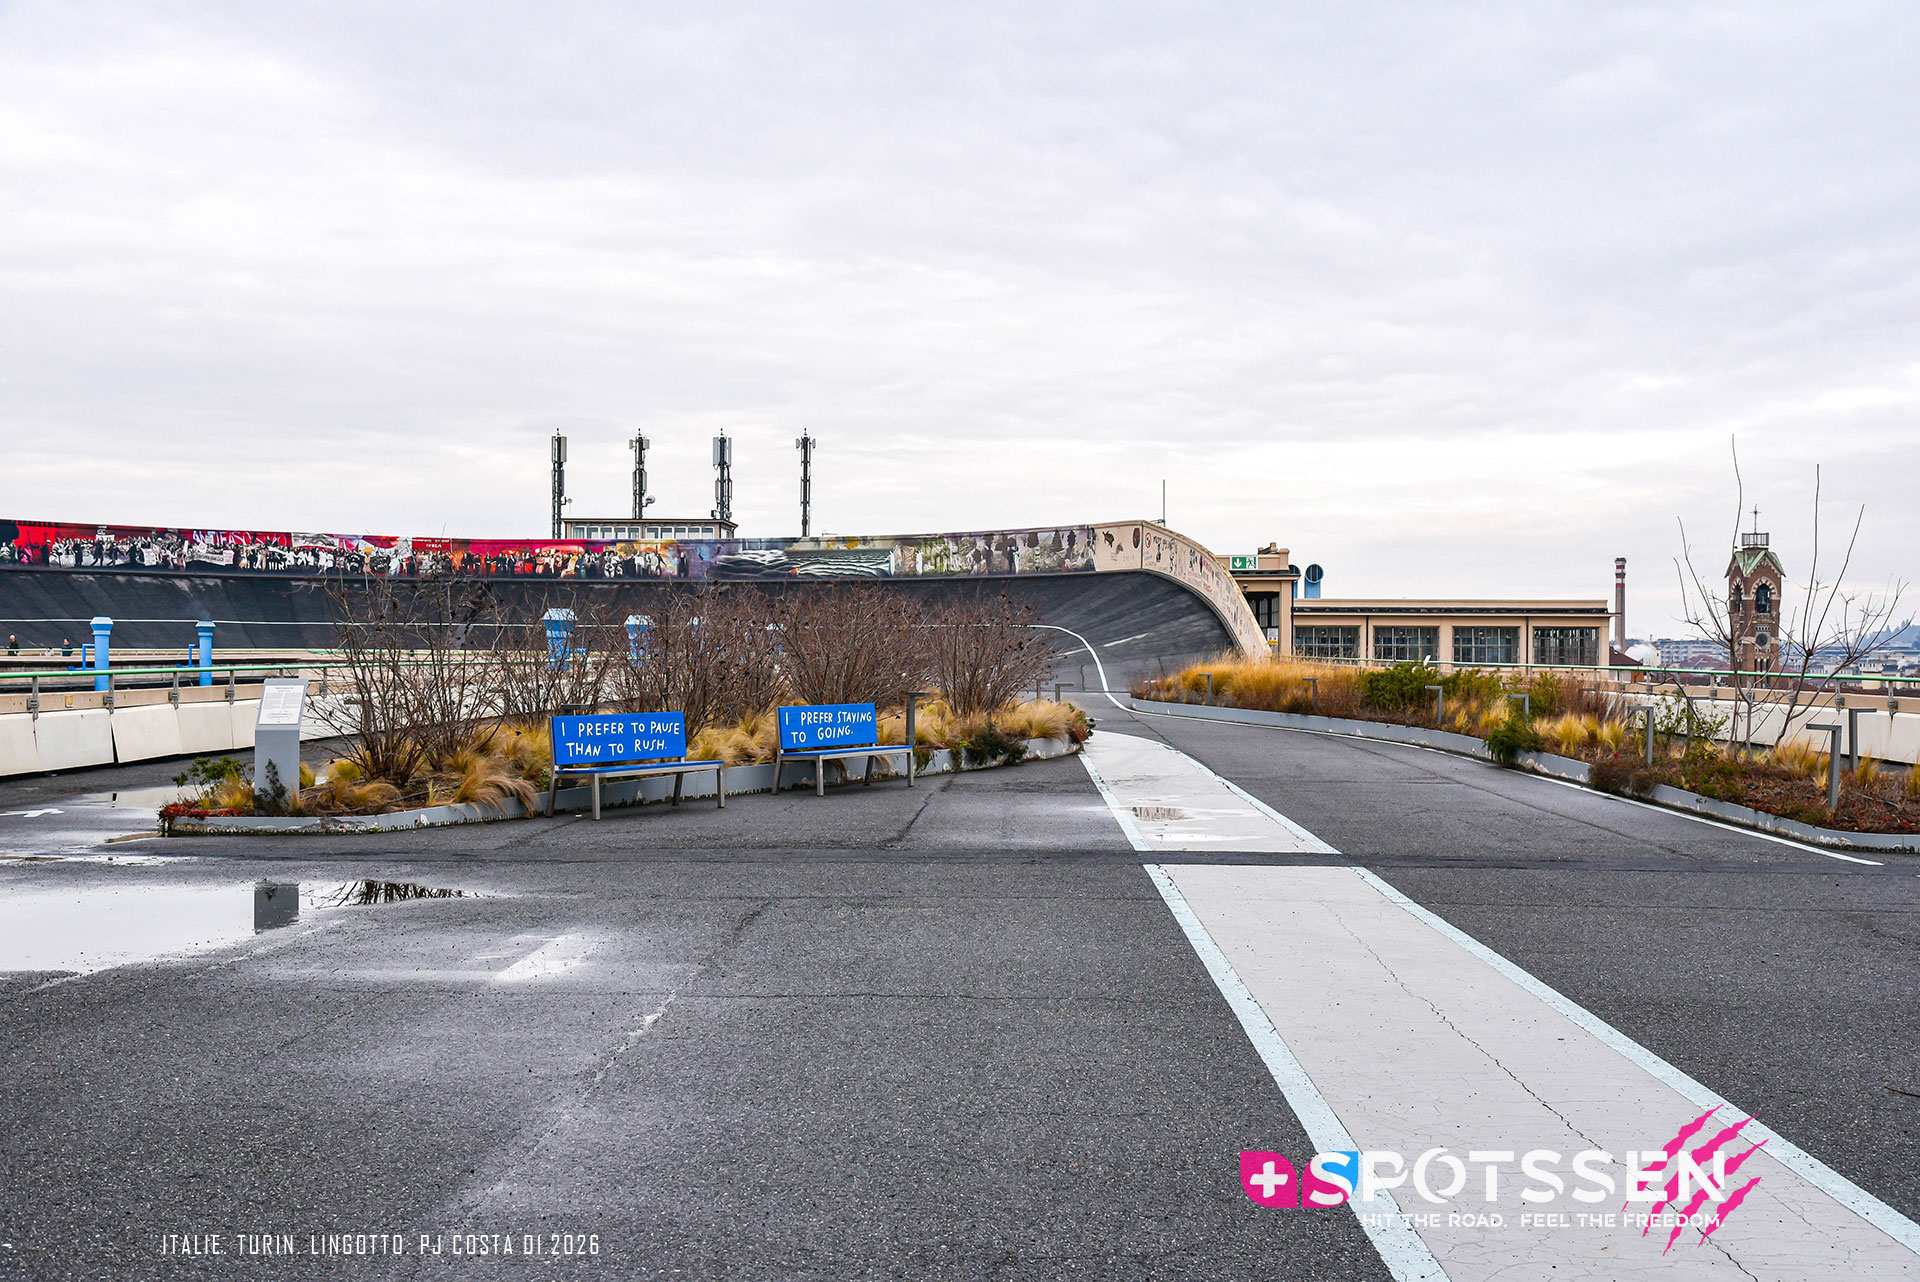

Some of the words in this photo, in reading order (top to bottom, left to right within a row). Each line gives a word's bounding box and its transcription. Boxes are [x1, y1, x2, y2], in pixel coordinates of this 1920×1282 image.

[785, 712, 789, 726] I
[801, 712, 833, 726] PREFER
[837, 711, 872, 724] STAYING
[562, 722, 565, 736] I
[578, 722, 624, 737] PREFER
[631, 722, 645, 734] TO
[650, 721, 680, 735] PAUSE
[791, 731, 806, 744] TO
[817, 725, 854, 740] GOING.
[566, 742, 601, 757] THAN
[608, 743, 624, 756] TO
[634, 739, 667, 752] RUSH.
